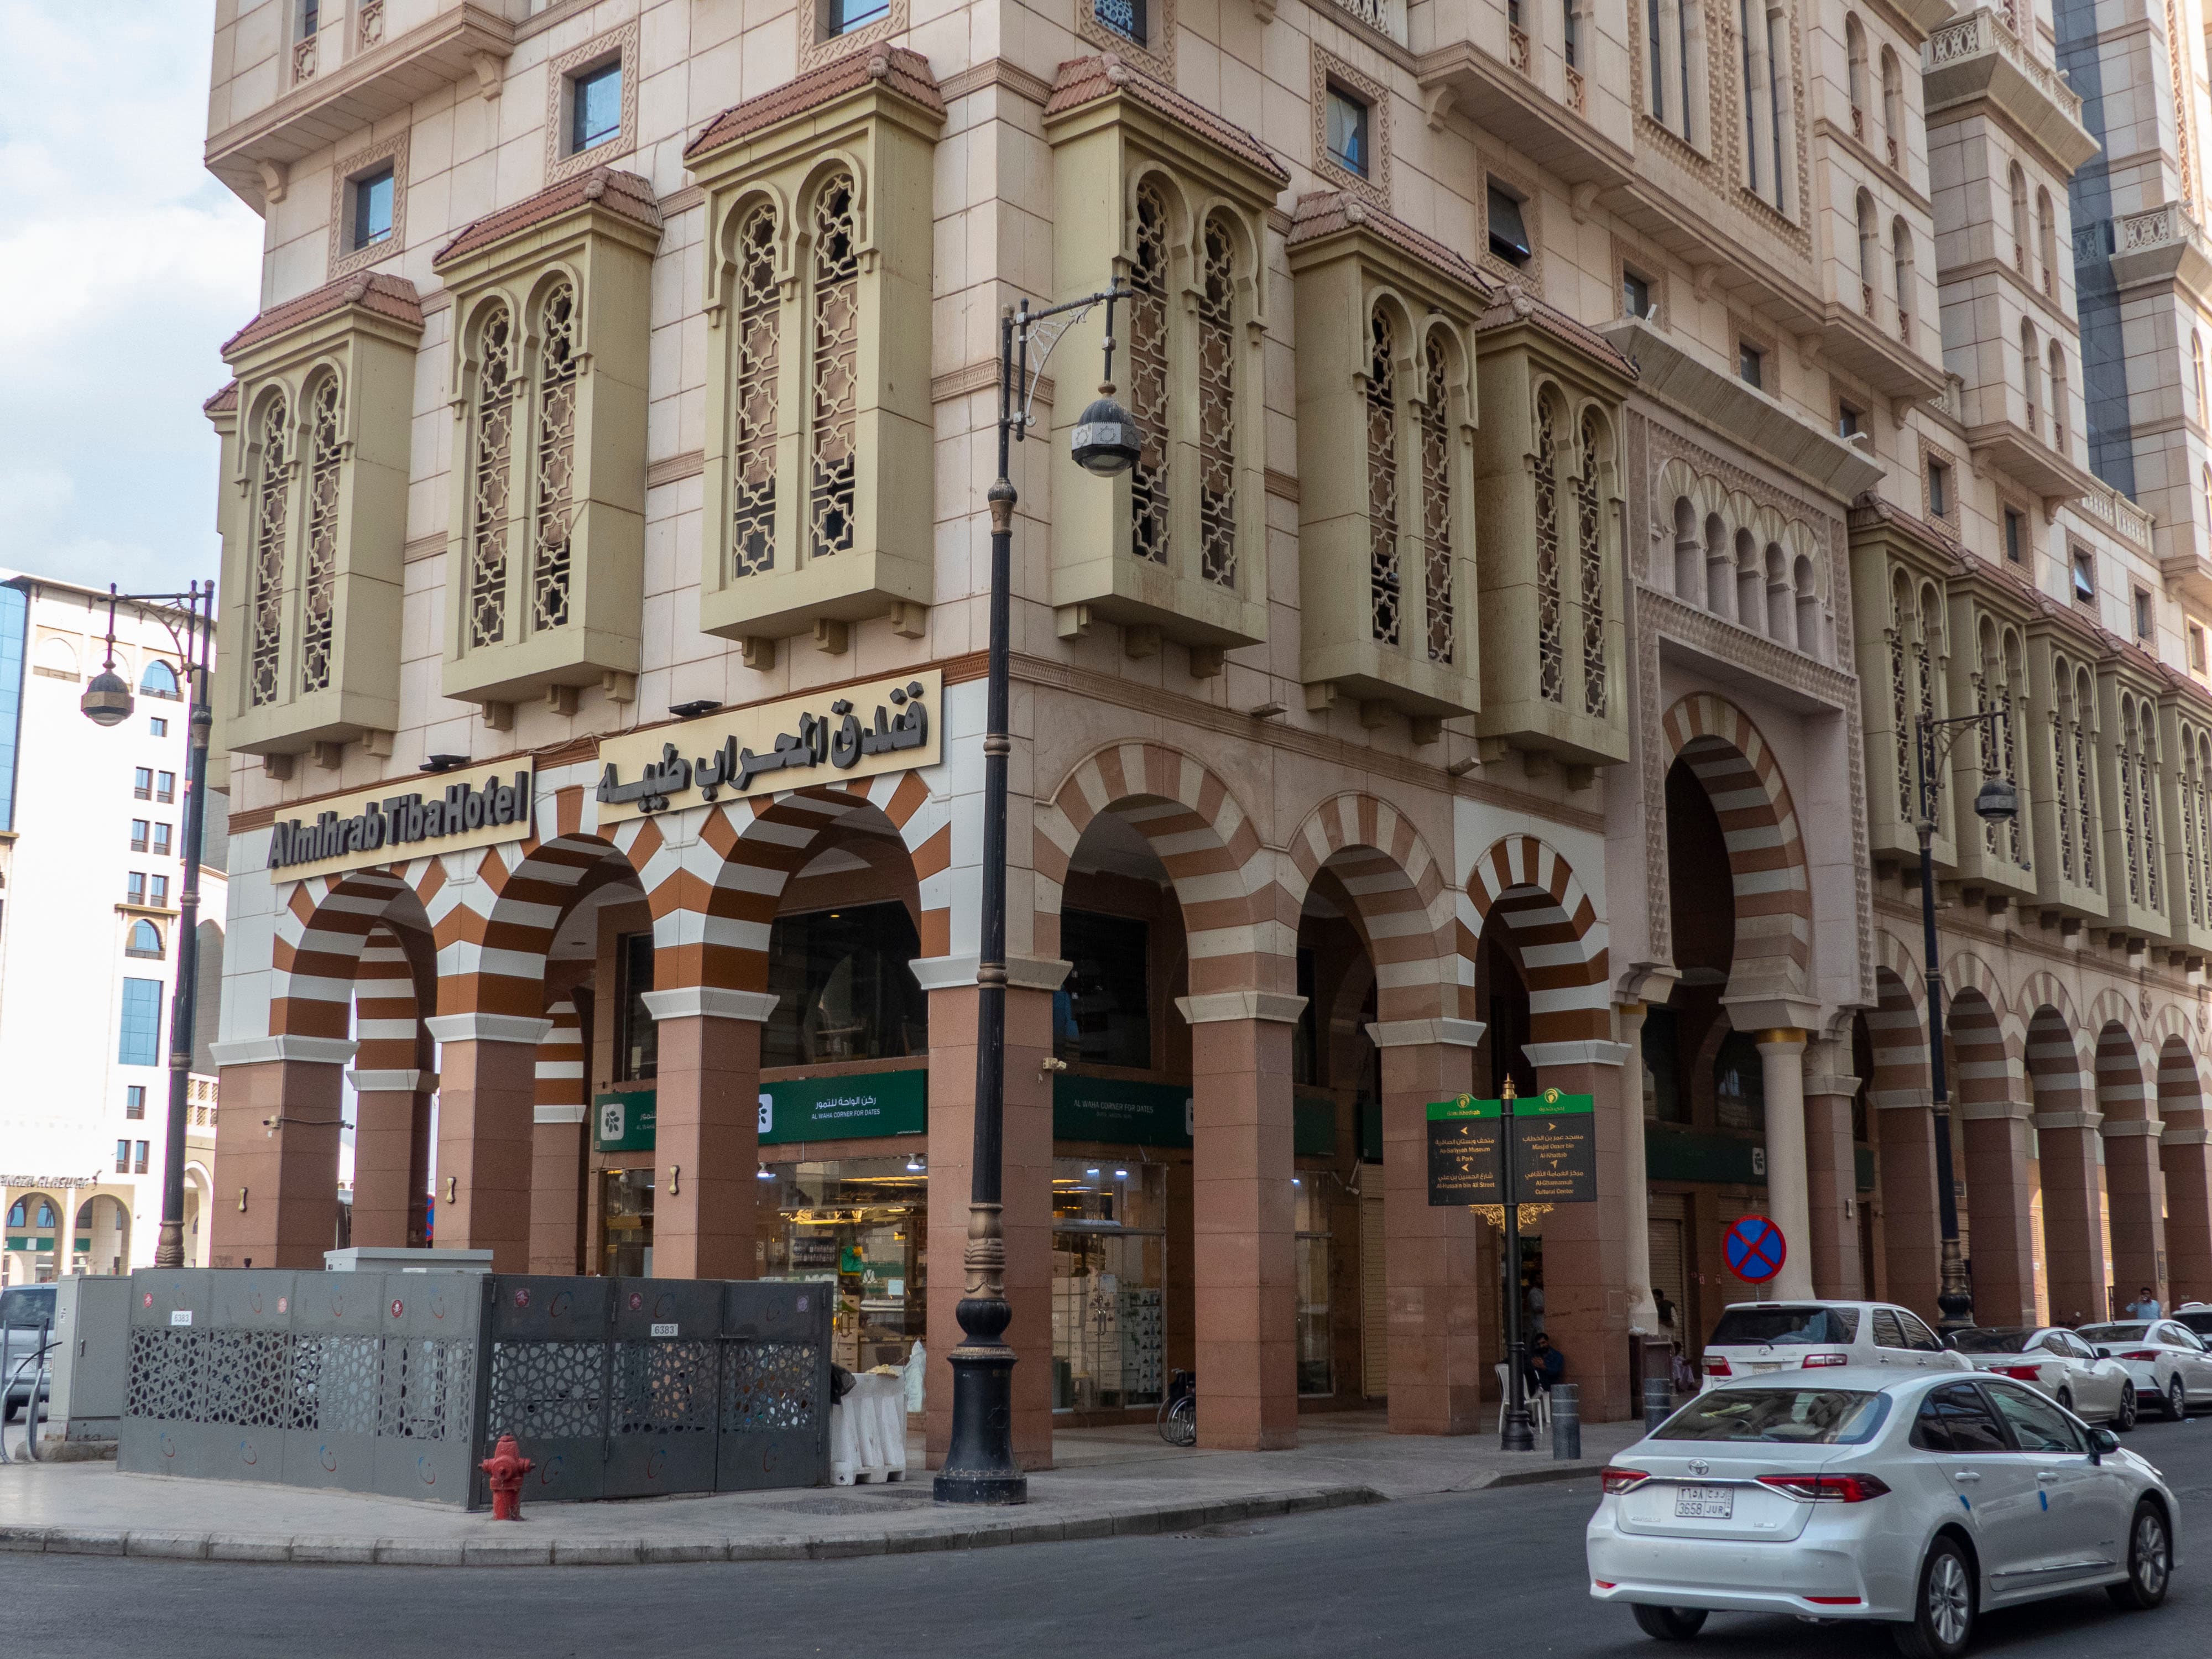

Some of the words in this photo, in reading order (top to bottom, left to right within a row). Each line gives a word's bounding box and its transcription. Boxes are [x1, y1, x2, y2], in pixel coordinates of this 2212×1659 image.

[831, 681, 929, 770] فندق
[695, 711, 829, 802] المحراب
[267, 802, 386, 869] Almihrab
[383, 793, 446, 846] Tiba
[444, 770, 529, 834] Hotel
[815, 1098, 837, 1109] للتمور
[838, 1097, 860, 1107] الواحة
[861, 1095, 877, 1106] ركن
[1082, 1100, 1099, 1109] WAHA
[1100, 1102, 1123, 1111] CORNER
[1124, 1104, 1135, 1112] FOR
[1136, 1104, 1154, 1114] DATES
[174, 1314, 189, 1322] 6383
[655, 1326, 674, 1334] 6383
[1678, 1503, 1703, 1515] 3658
[1706, 1505, 1724, 1514] JUR
